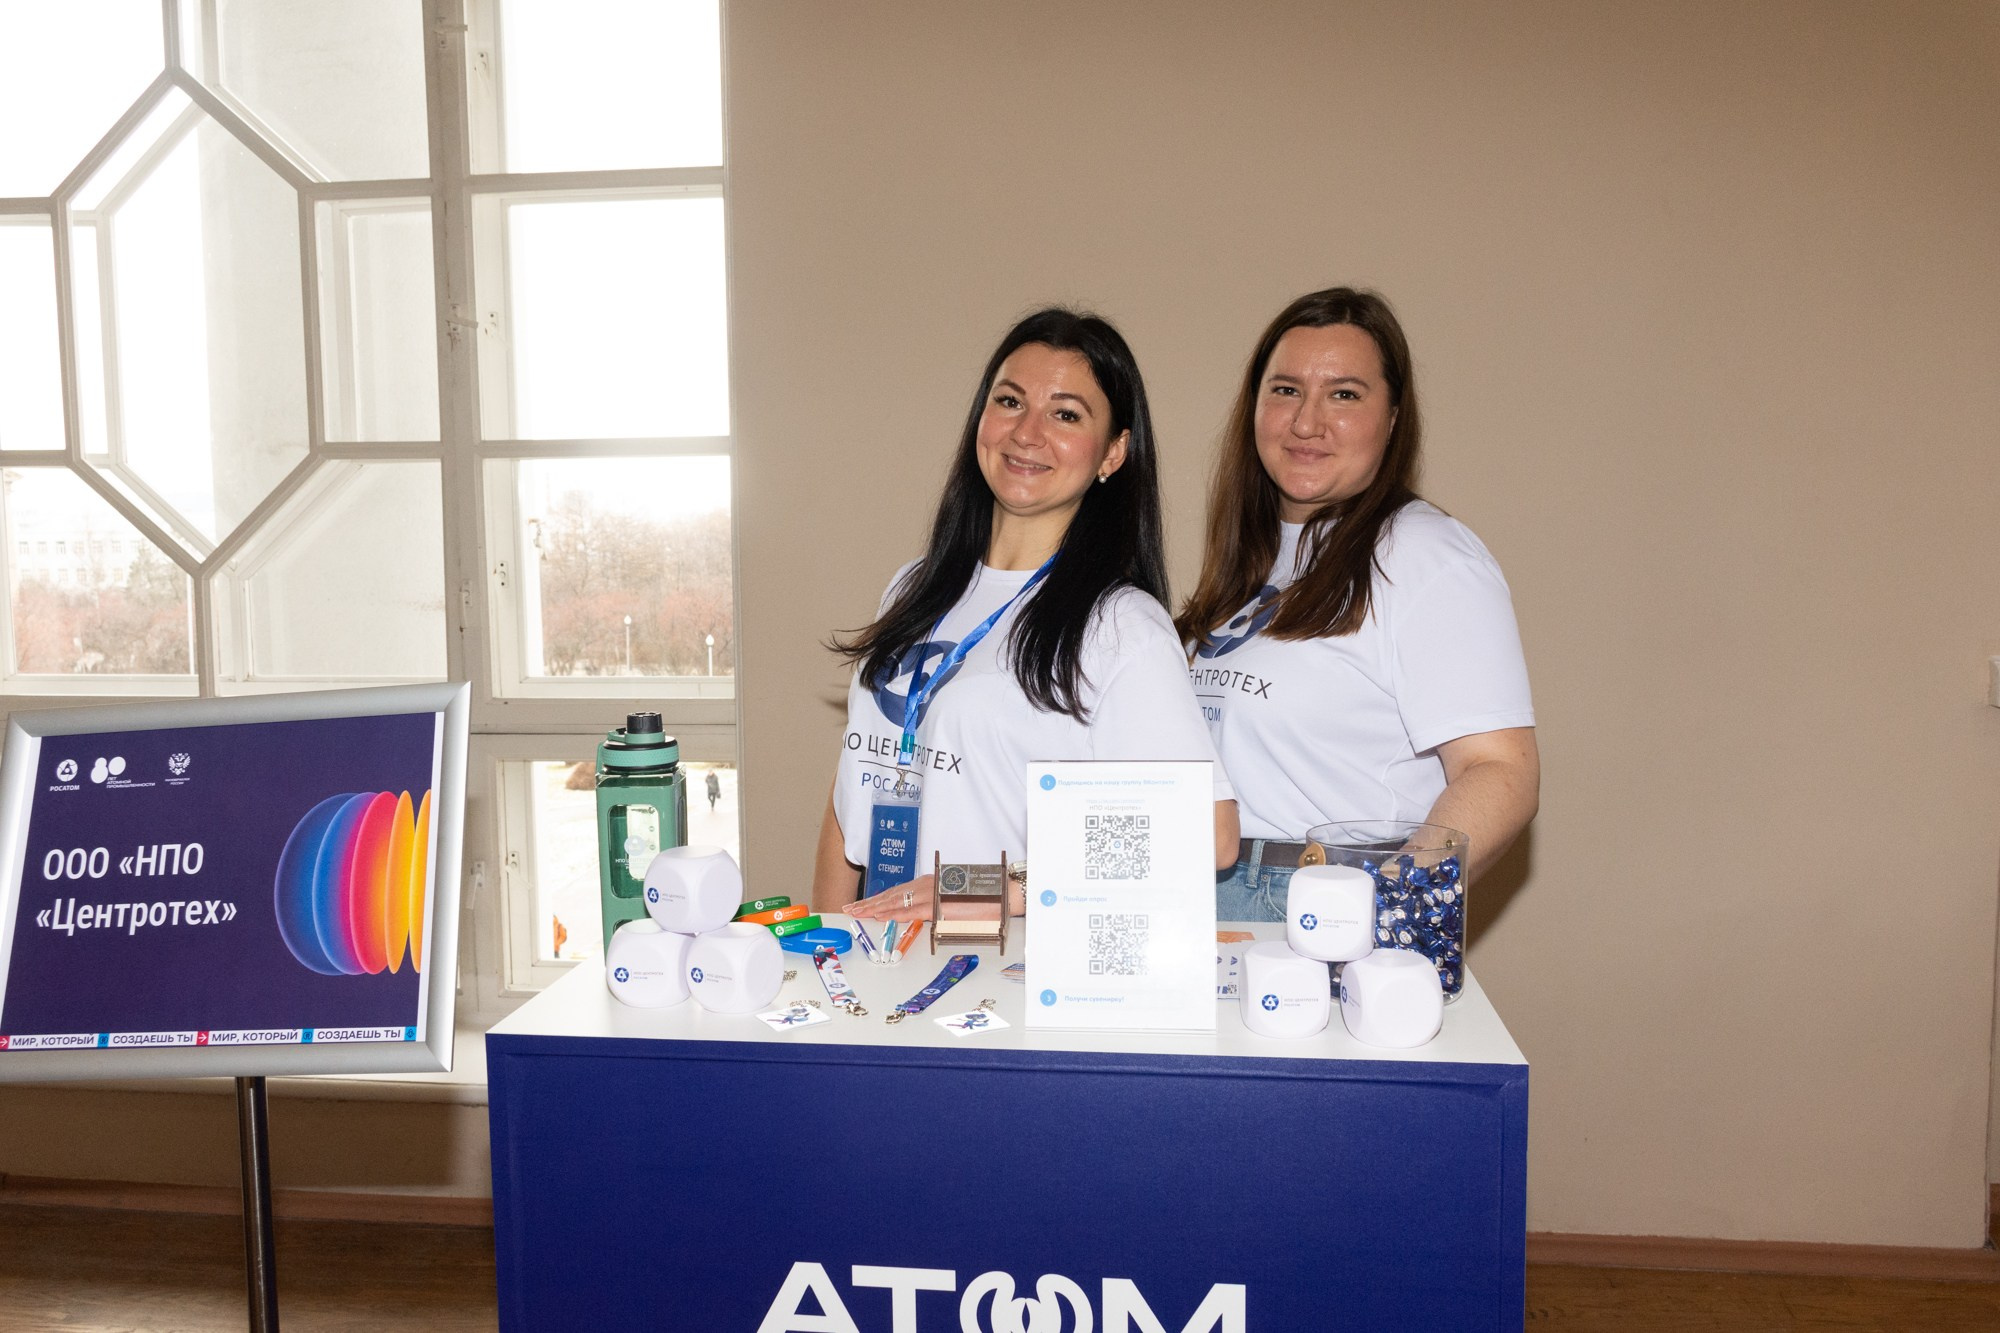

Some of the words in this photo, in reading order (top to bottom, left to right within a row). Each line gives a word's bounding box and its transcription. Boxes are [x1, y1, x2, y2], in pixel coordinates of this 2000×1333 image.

[1189, 668, 1272, 700] НТРОТЕХ
[49, 784, 80, 792] РОСАТОМ
[43, 847, 110, 881] ООО
[119, 842, 204, 877] «НПО
[880, 847, 906, 858] ФЕСТ
[878, 863, 905, 875] СТЕНДИСТ
[35, 897, 238, 937] «Центротех»
[12, 1037, 38, 1047] МИР,
[41, 1033, 95, 1046] КОТОРЫЙ
[112, 1036, 175, 1045] СОЗДАЕШЬ
[177, 1034, 194, 1043] ТЫ
[211, 1032, 240, 1043] МИР,
[242, 1028, 299, 1041] КОТОРЫЙ
[317, 1031, 382, 1040] СОЗДАЕШЬ
[384, 1029, 402, 1038] ТЫ
